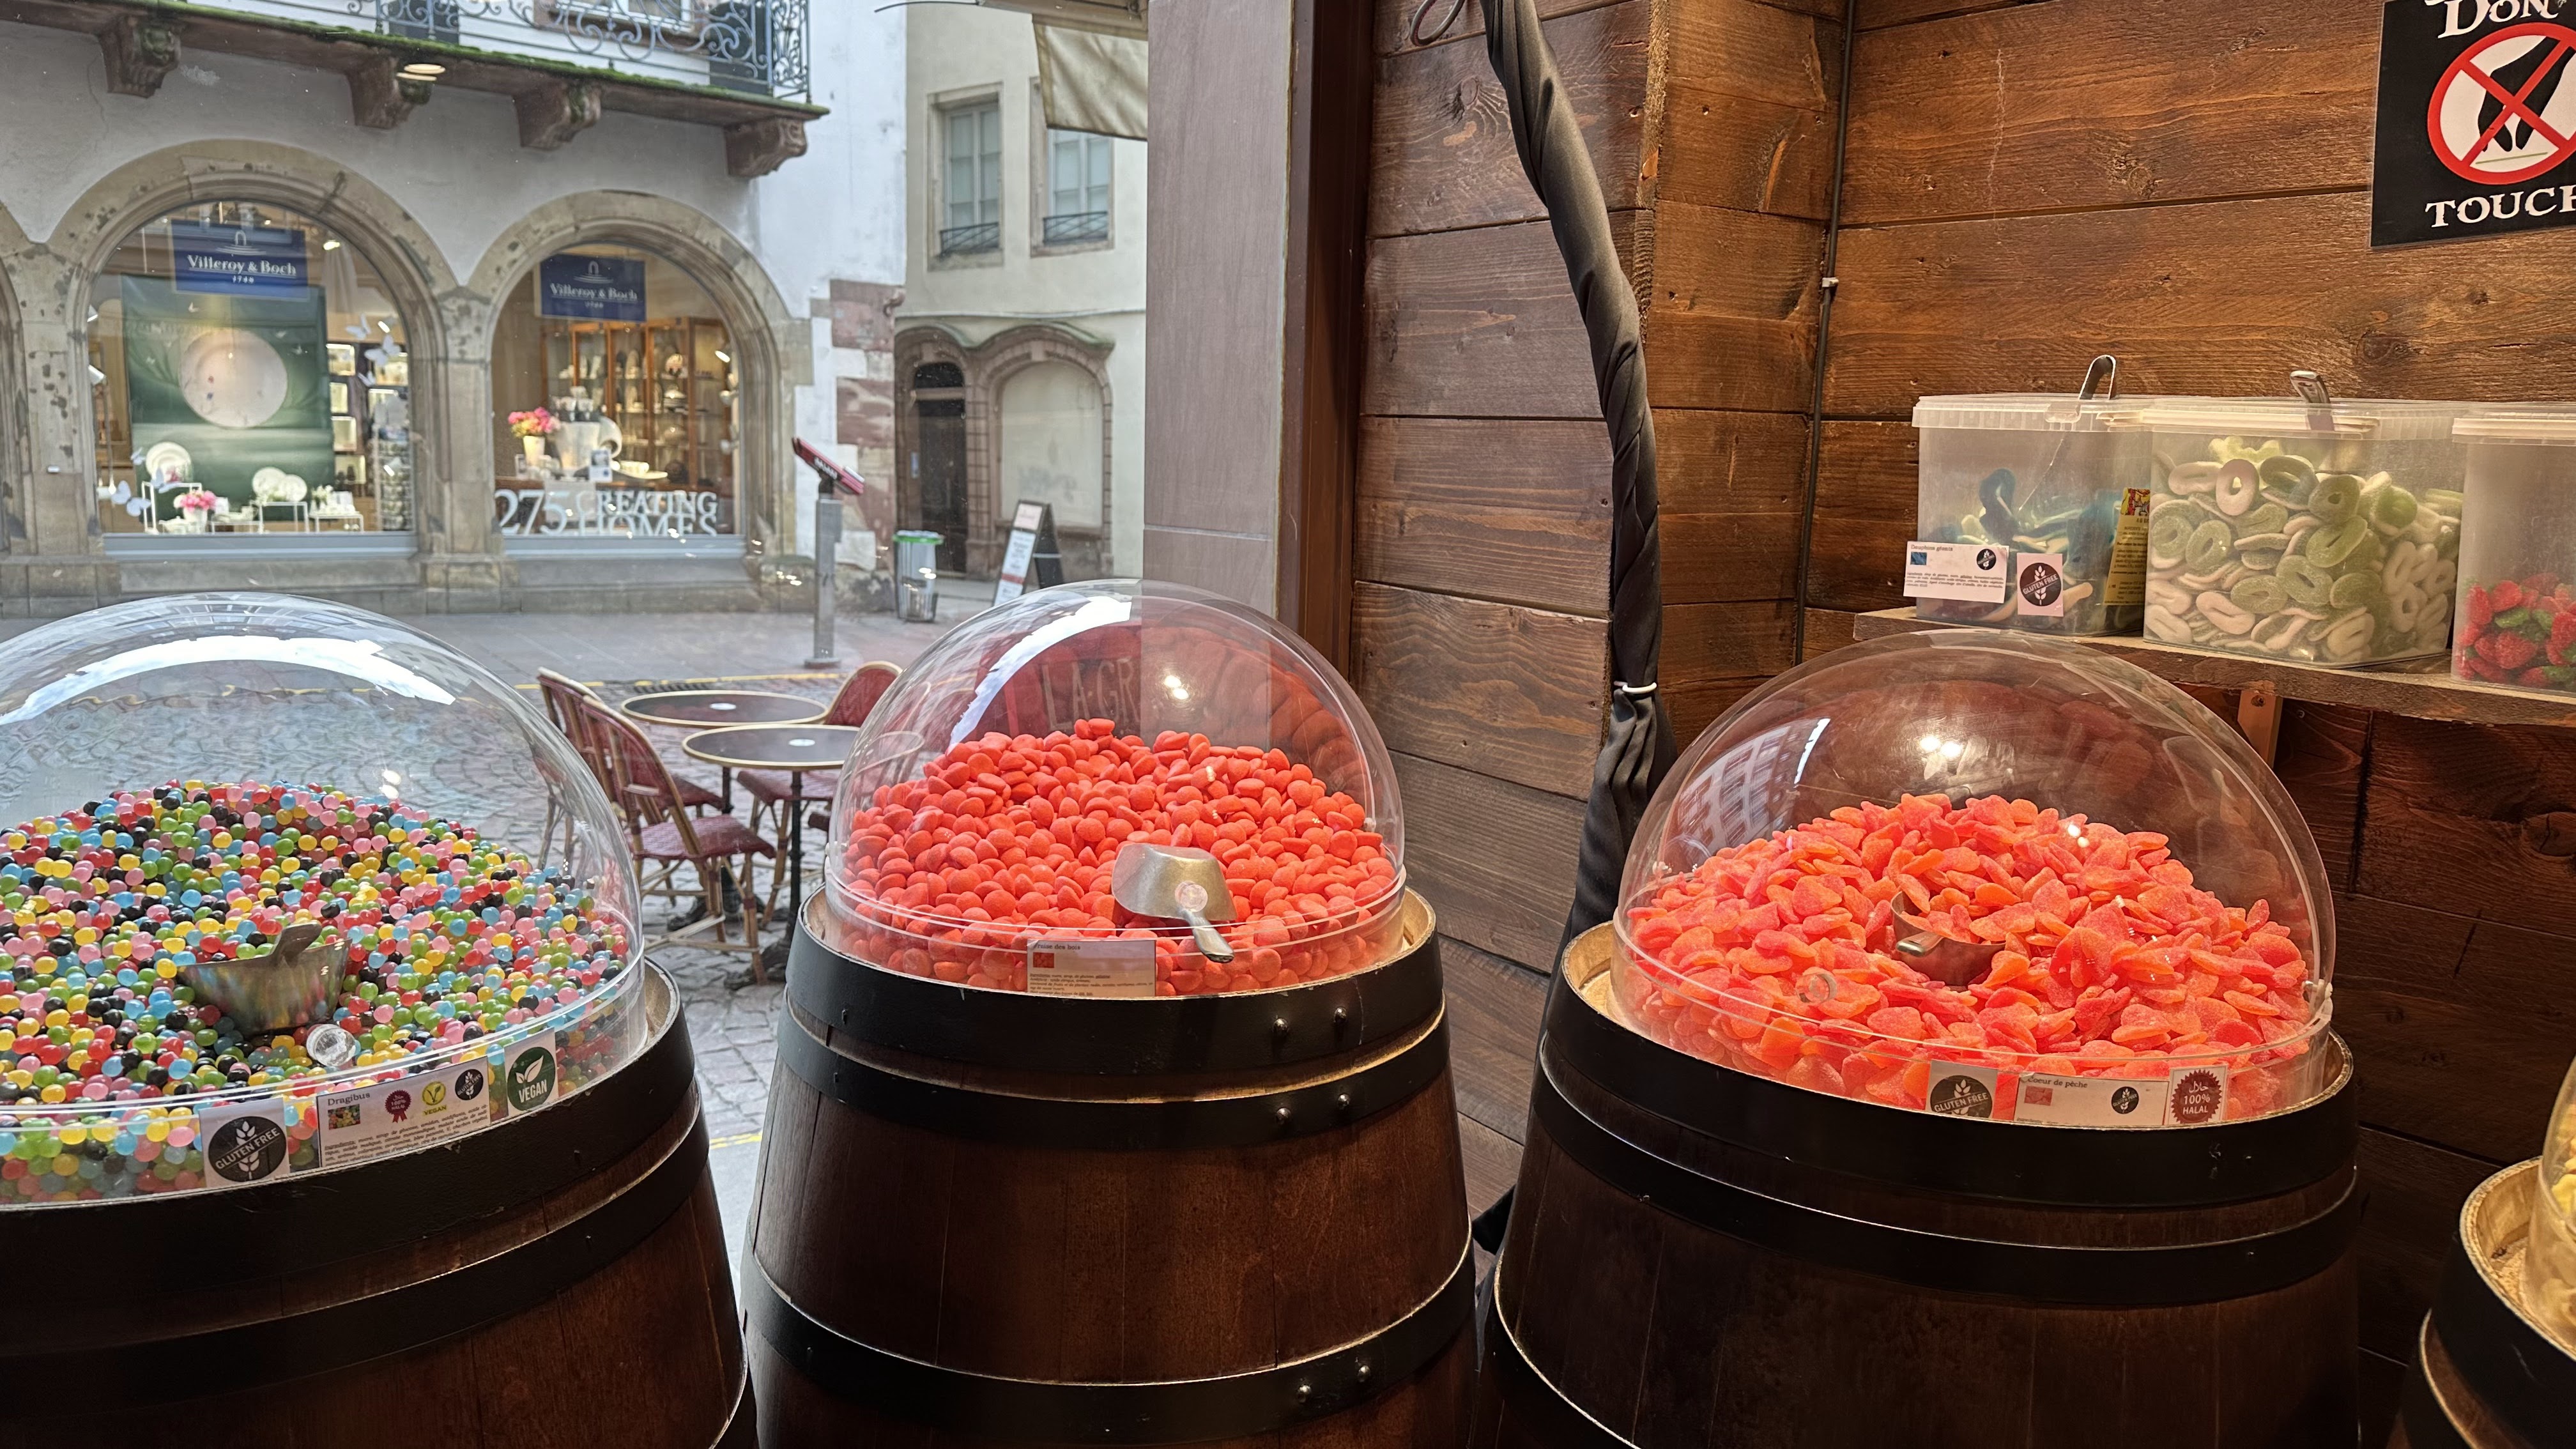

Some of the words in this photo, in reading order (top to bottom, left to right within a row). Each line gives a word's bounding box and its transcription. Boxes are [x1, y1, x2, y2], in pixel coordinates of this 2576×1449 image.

[187, 254, 245, 274] Villeroy
[248, 261, 257, 272] &
[261, 260, 296, 275] Boch
[550, 283, 595, 298] Villeroy
[599, 289, 606, 298] &
[608, 288, 637, 300] Boch
[494, 489, 567, 535] 275
[576, 489, 717, 519] CREATING
[2023, 581, 2044, 594] GLUTEN
[2044, 574, 2058, 585] FREE
[518, 1079, 548, 1103] VEGAN
[2188, 1080, 2209, 1093] حلال
[328, 1092, 370, 1105] Dragibus
[1934, 1099, 1966, 1112] GLUTEN
[1968, 1092, 1988, 1104] FREE
[2184, 1093, 2211, 1105] 100%
[424, 1105, 447, 1116] VEGAN
[2182, 1105, 2209, 1115] HALAL
[215, 1142, 255, 1169] GLUTEN
[254, 1128, 280, 1147] FREE
